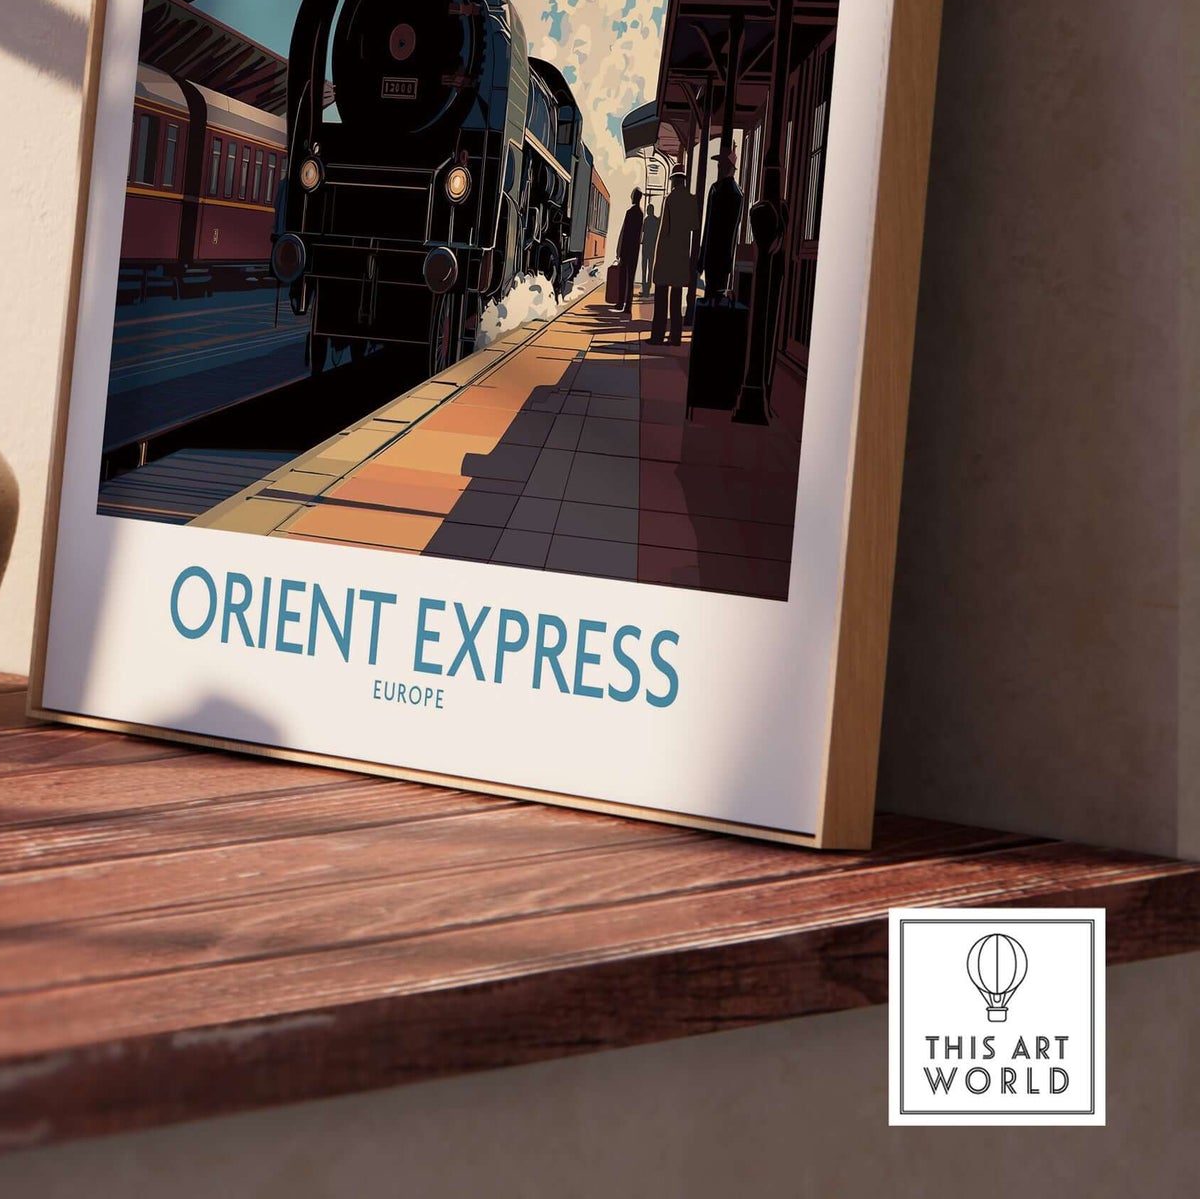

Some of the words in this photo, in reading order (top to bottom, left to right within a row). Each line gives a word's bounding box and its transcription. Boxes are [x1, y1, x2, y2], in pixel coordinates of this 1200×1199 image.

[170, 565, 397, 665] ORIENT
[413, 597, 680, 708] EXPRESS
[373, 679, 444, 709] EUROPE
